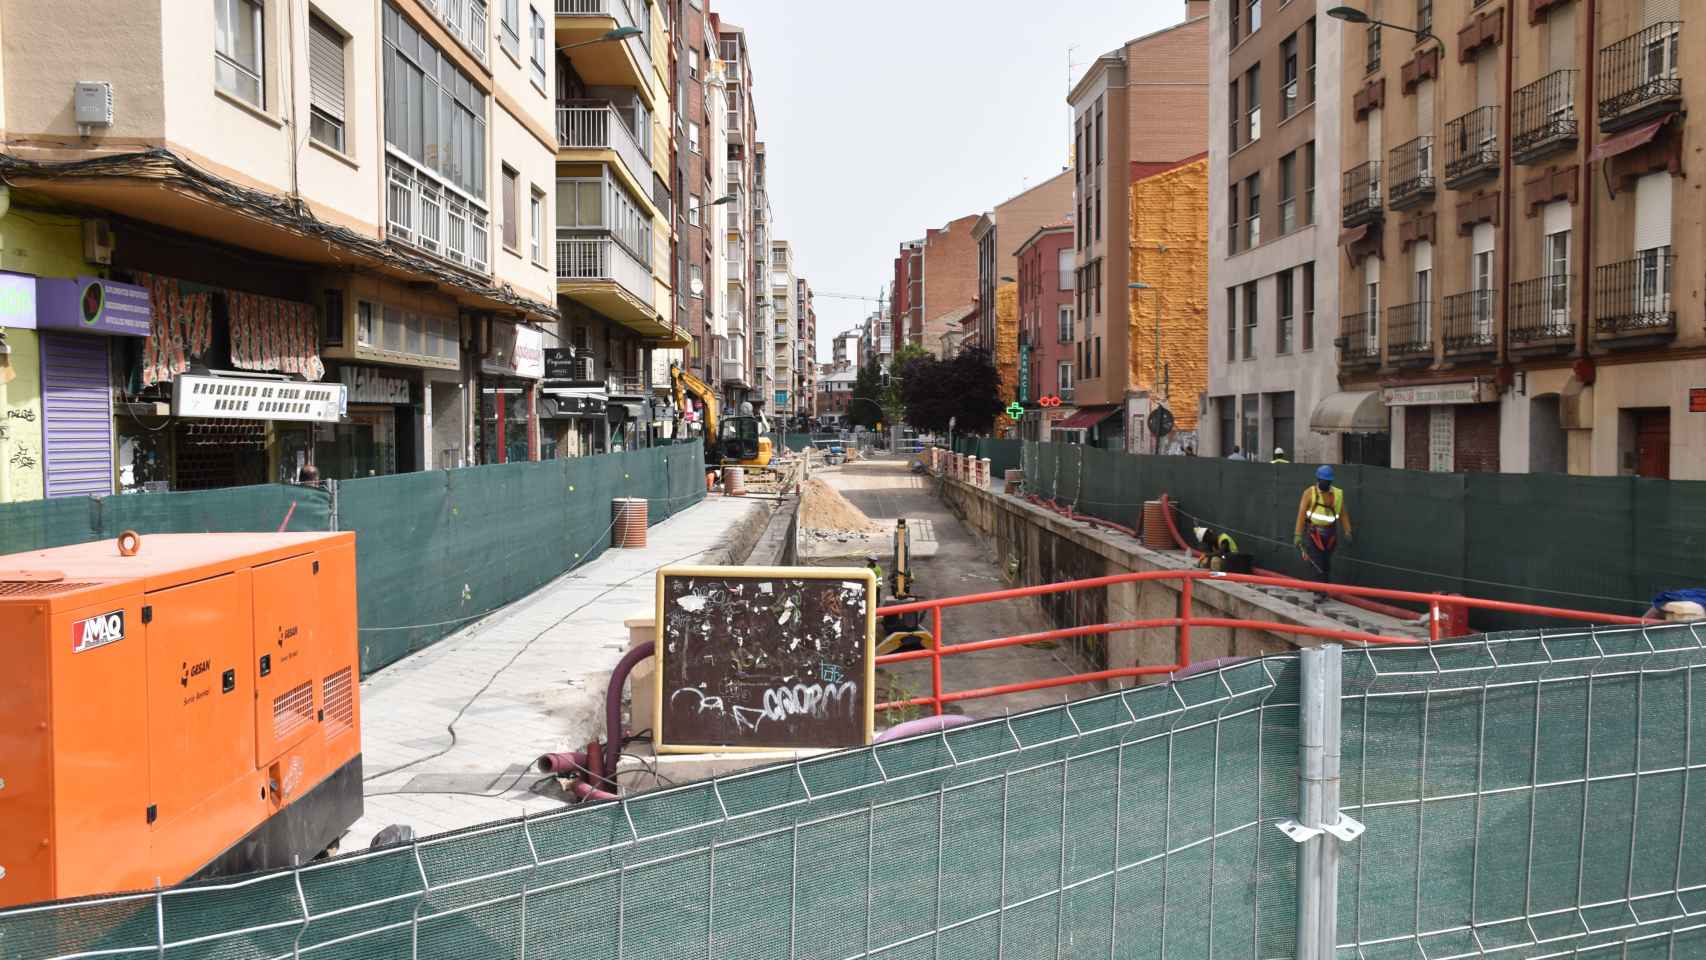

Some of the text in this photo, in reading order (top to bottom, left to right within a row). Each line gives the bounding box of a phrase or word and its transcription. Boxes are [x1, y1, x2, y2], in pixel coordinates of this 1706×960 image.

[193, 383, 258, 397] PRODUCTOS
[261, 387, 274, 398] DE
[76, 615, 122, 651] AMAQ
[191, 659, 210, 677] GESAN
